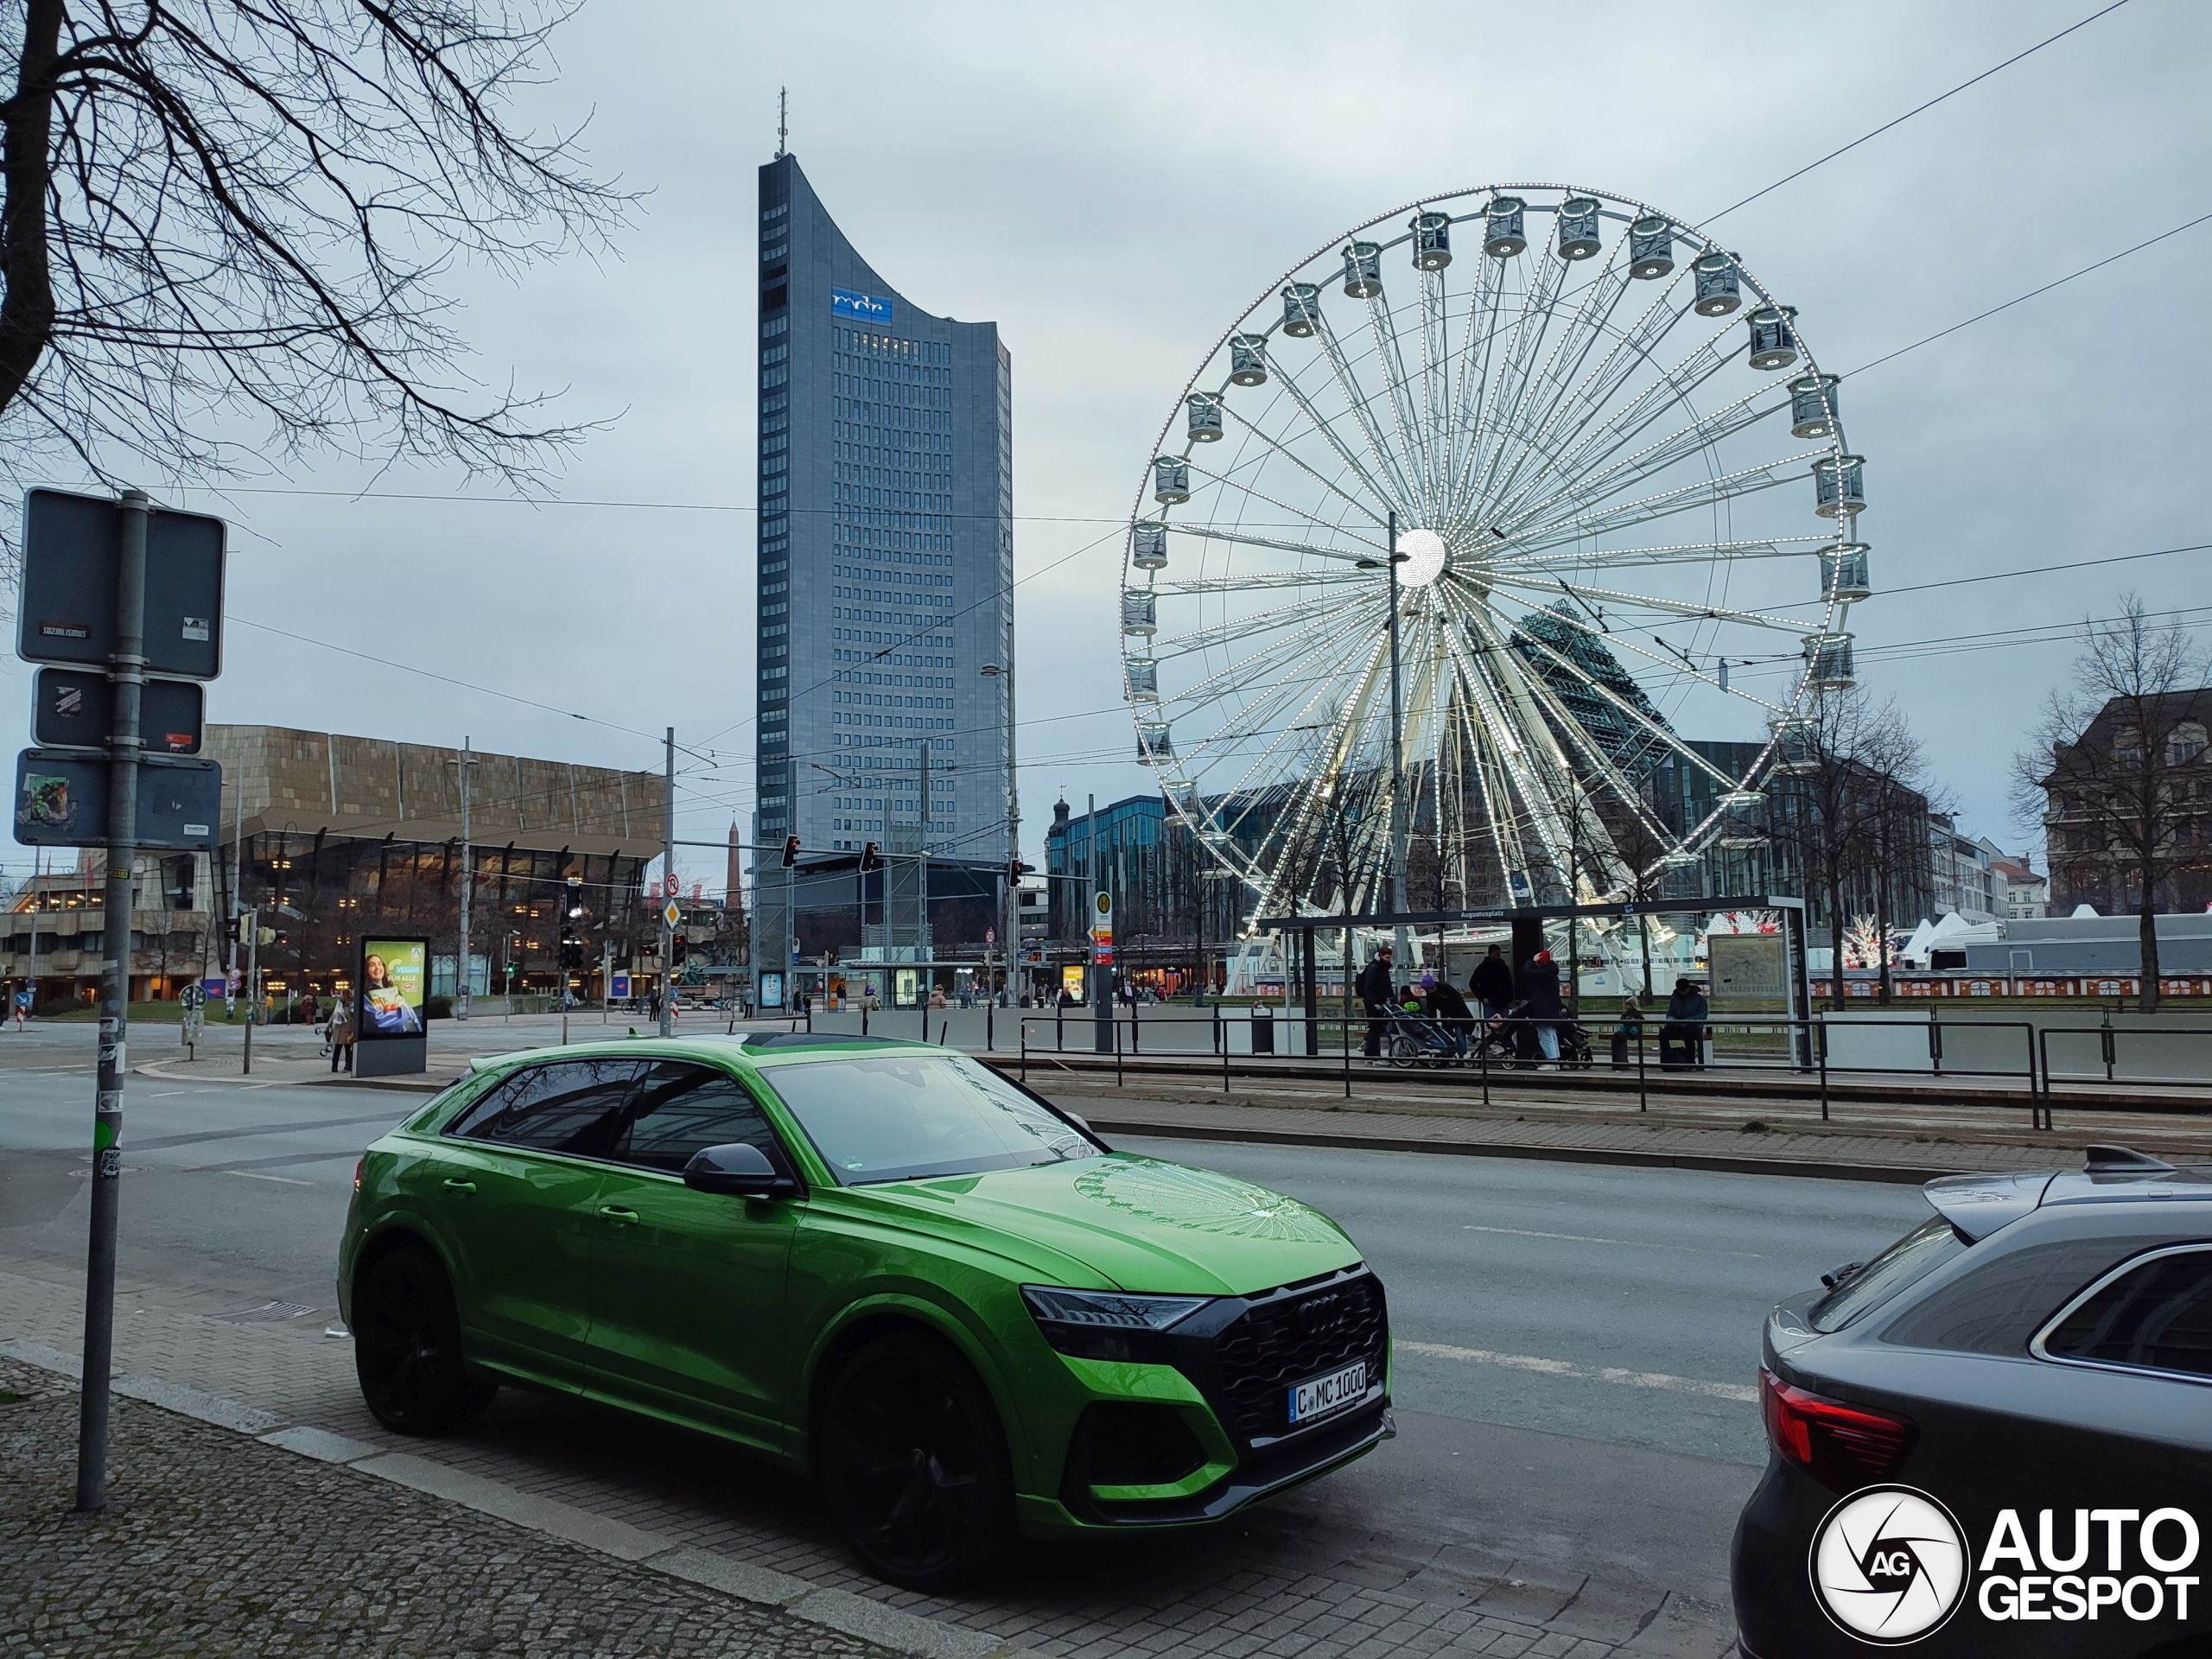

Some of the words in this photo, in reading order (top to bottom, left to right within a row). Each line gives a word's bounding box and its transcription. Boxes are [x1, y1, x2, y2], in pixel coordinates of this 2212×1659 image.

[832, 295, 882, 313] mdr
[1298, 1389, 1306, 1414] C
[1316, 1379, 1332, 1408] MC
[1336, 1366, 1364, 1400] 1000
